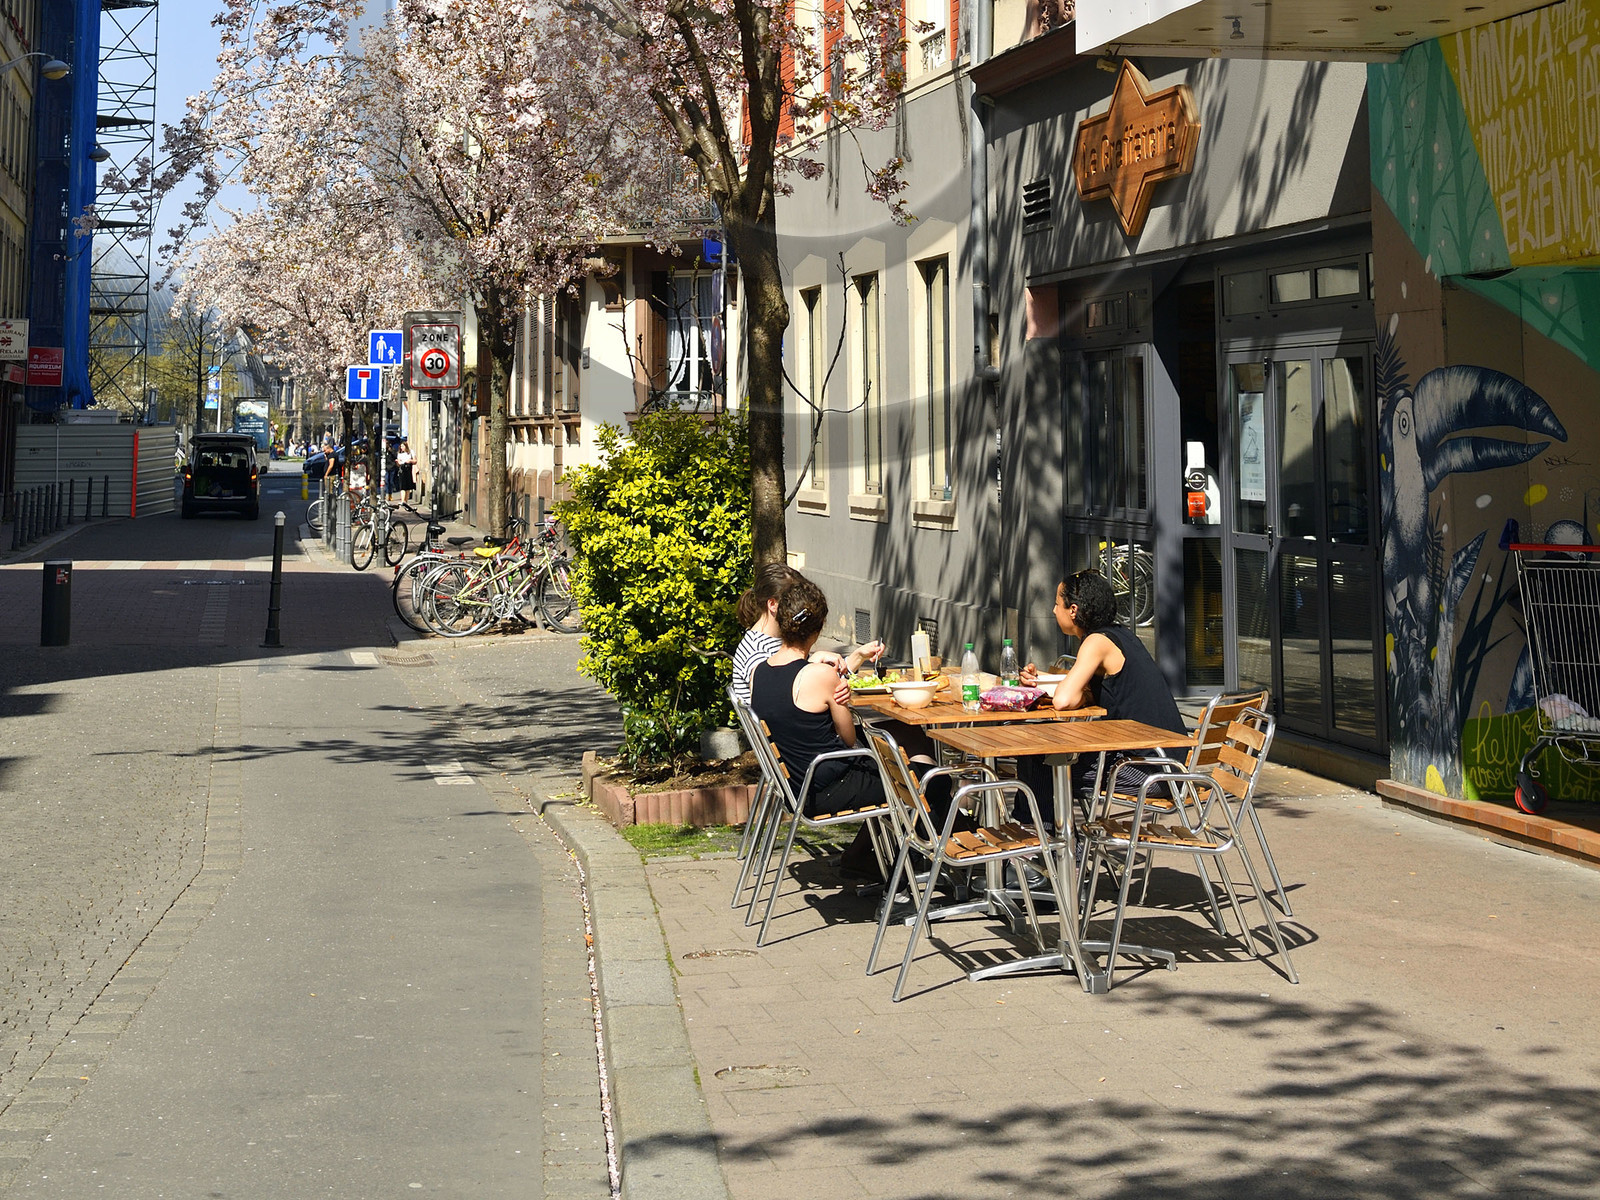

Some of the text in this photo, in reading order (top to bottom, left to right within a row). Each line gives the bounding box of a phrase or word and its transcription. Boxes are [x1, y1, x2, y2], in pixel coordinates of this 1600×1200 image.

[1456, 7, 1556, 126] MONSTA
[422, 334, 449, 342] ZONE
[426, 357, 444, 370] 30
[1470, 762, 1517, 789] worl
